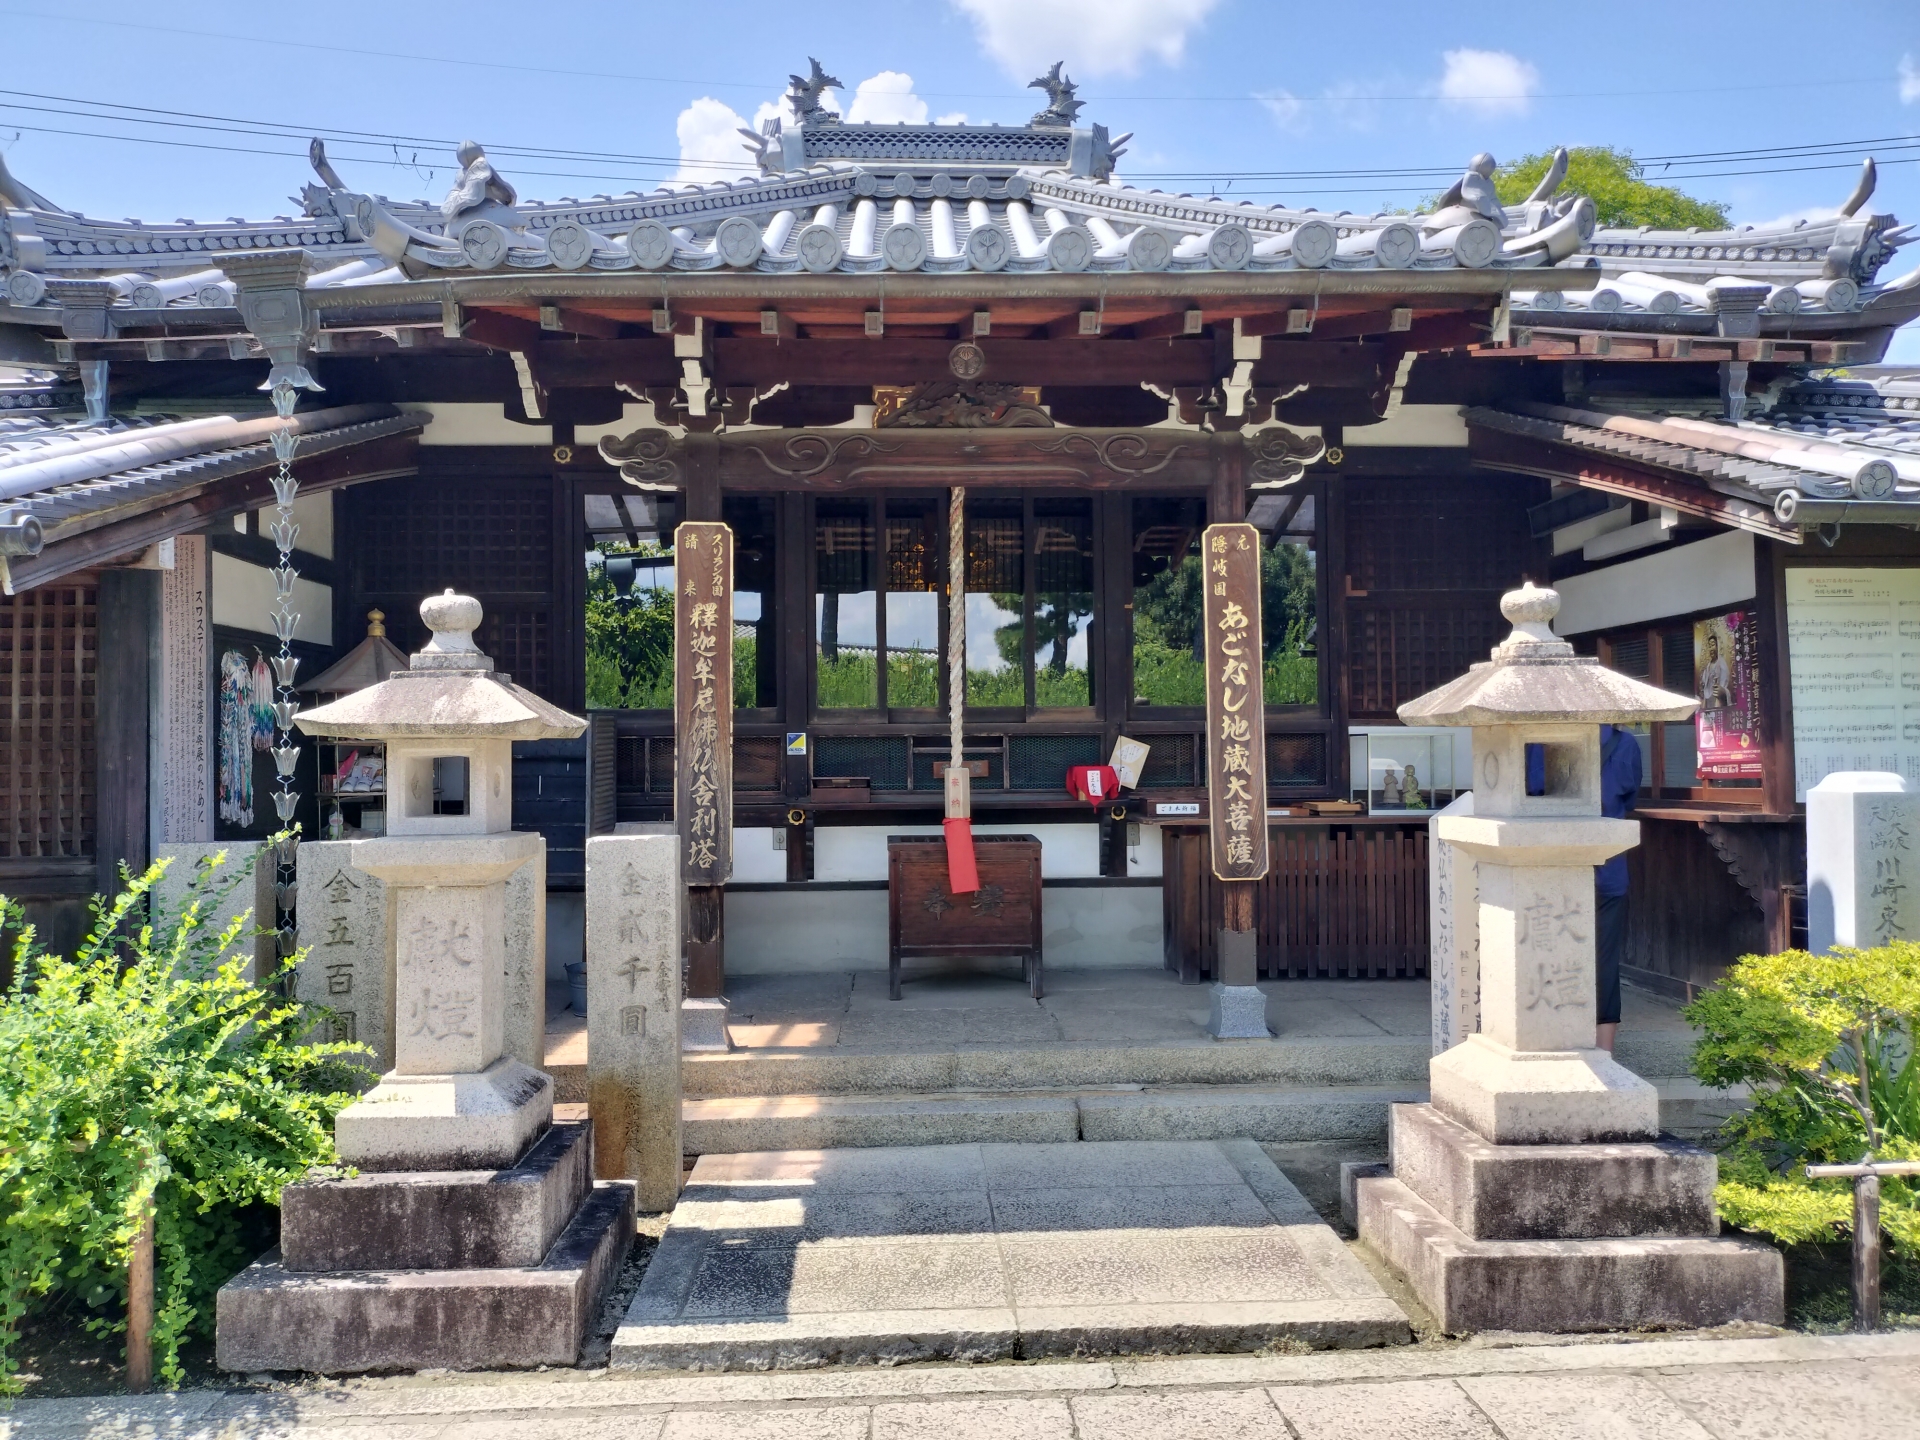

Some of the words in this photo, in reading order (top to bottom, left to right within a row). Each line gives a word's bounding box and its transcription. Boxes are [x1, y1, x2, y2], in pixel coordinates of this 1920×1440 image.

[1236, 534, 1250, 551] 元
[1218, 601, 1255, 865] あごなし地蔵大菩薩
